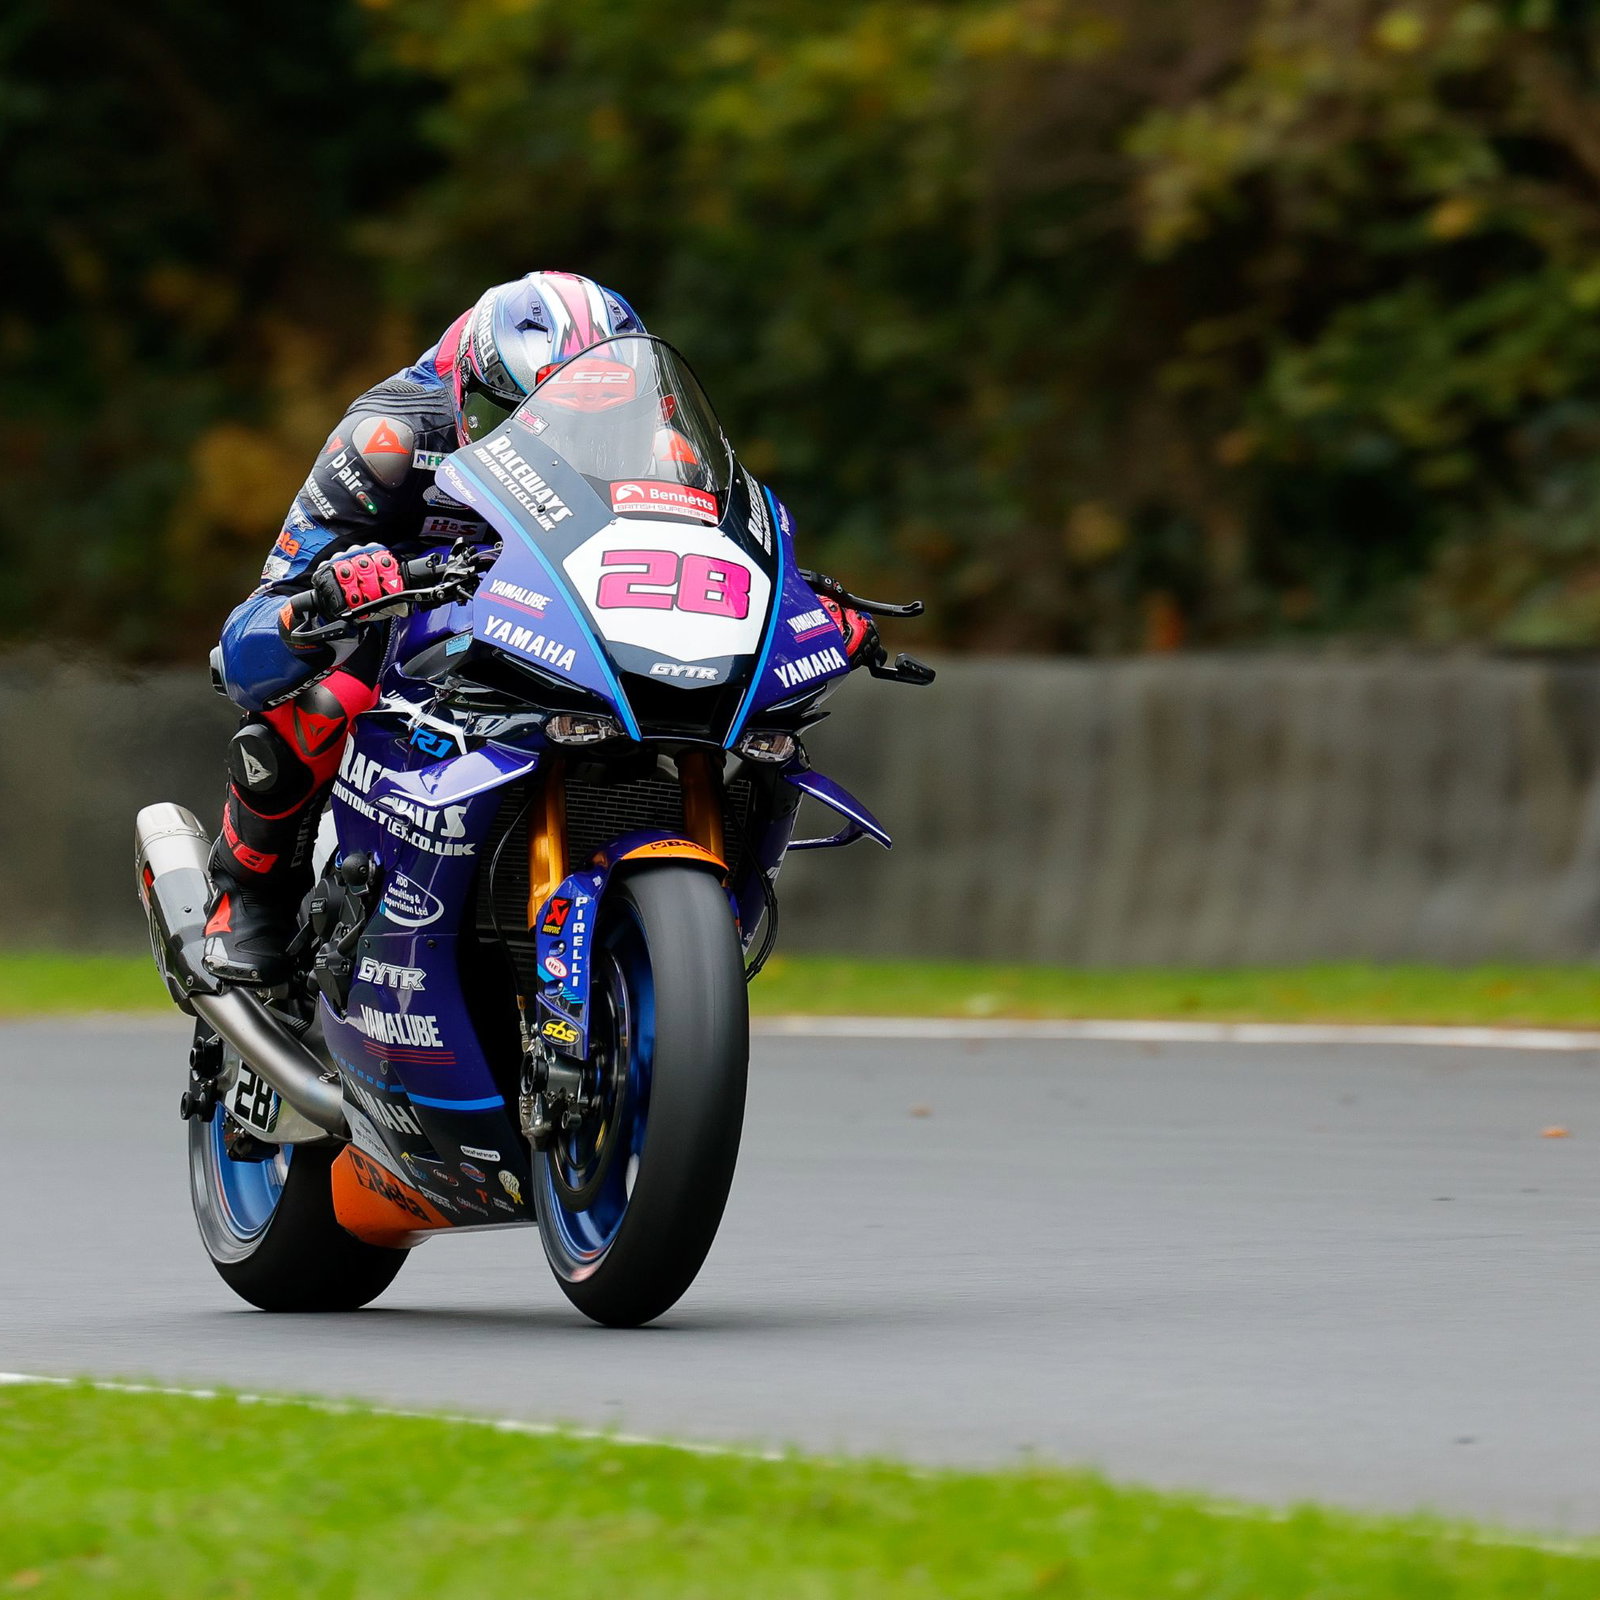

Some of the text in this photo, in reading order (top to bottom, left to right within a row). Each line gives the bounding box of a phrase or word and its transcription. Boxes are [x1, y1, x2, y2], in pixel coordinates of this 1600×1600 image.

[485, 435, 574, 523] RACEWAYS
[617, 503, 656, 511] BRITISH
[649, 488, 714, 511] Bennetts
[489, 579, 550, 611] YAMALUBE
[596, 549, 750, 620] 28
[786, 608, 830, 633] YAMALUBE
[483, 615, 576, 672] YAMAHA
[649, 662, 719, 681] GYTR
[773, 646, 847, 688] YAMAHA
[414, 894, 421, 904] &
[414, 905, 429, 916] Ltd
[571, 896, 589, 987] PIRELLI
[357, 956, 427, 991] GYTR
[360, 1004, 444, 1048] YAMALUBE
[234, 1063, 275, 1130] 28
